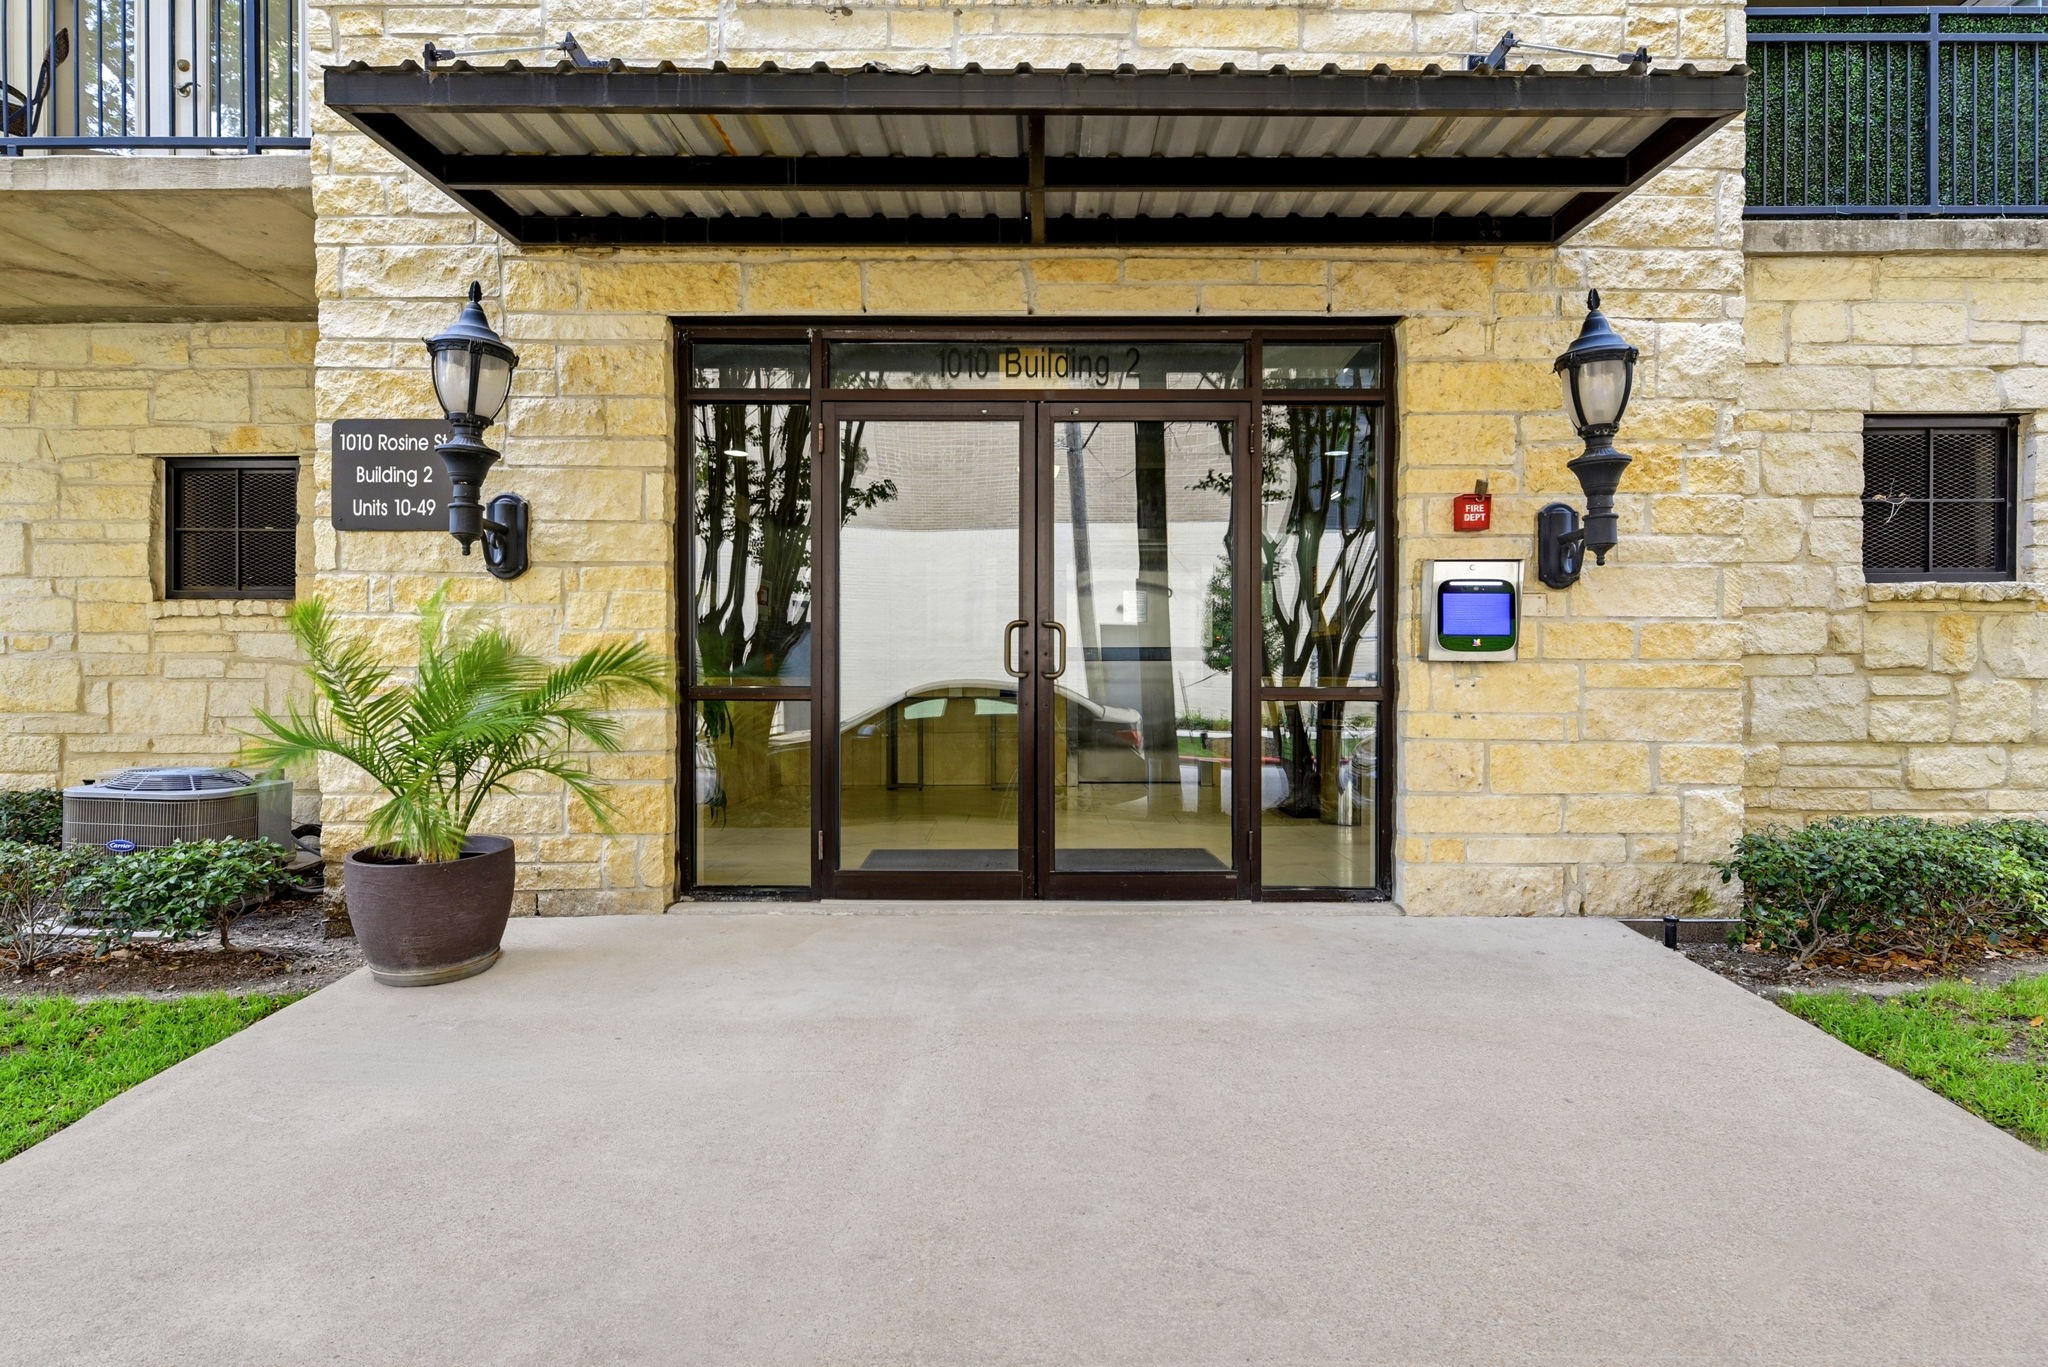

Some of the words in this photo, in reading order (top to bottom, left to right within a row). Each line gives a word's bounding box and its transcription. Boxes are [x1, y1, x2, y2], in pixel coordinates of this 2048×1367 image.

[935, 347, 989, 379] 1010
[1005, 347, 1109, 386] Building
[1125, 347, 1141, 379] 2
[339, 433, 373, 451] 1010
[378, 433, 430, 451] Rosine
[433, 433, 448, 449] St
[356, 466, 418, 488] Building
[423, 466, 433, 483] 2
[352, 499, 388, 516] Units
[394, 499, 436, 516] 10-49
[1465, 504, 1485, 513] FIRE
[1463, 513, 1486, 522] DEPT
[109, 842, 133, 850] Carrier
